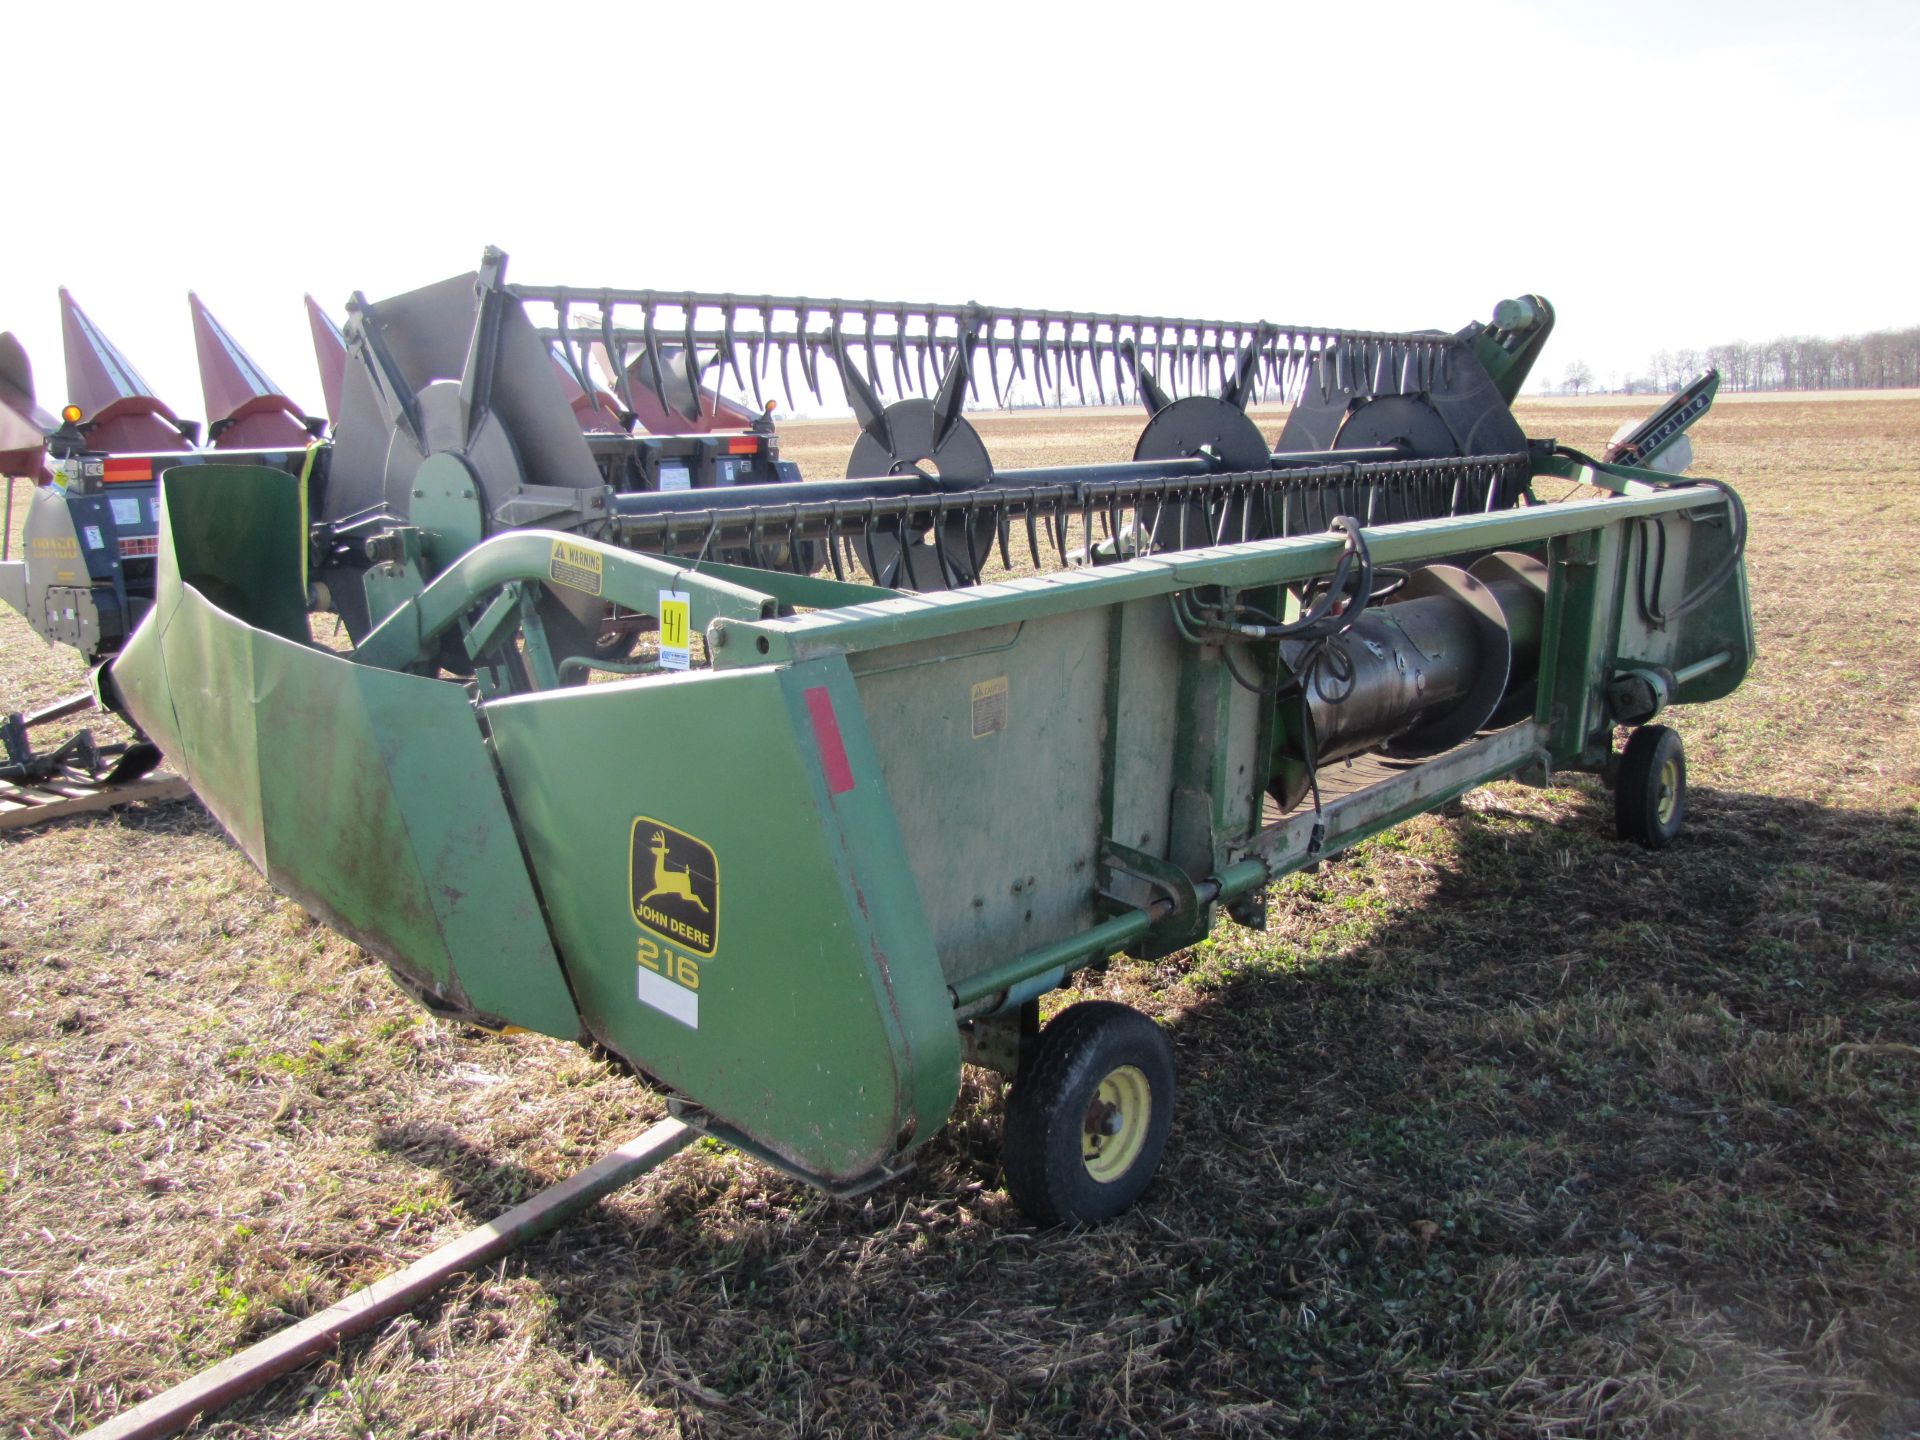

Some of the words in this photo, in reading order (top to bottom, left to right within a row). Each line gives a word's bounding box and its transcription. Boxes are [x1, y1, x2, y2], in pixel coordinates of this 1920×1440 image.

[1664, 424, 1671, 434] 2
[1648, 439, 1655, 448] 3
[569, 548, 600, 570] WARNING
[663, 609, 681, 643] 41
[636, 903, 667, 927] JOHN
[671, 918, 709, 947] DEERE
[638, 937, 699, 989] 216
